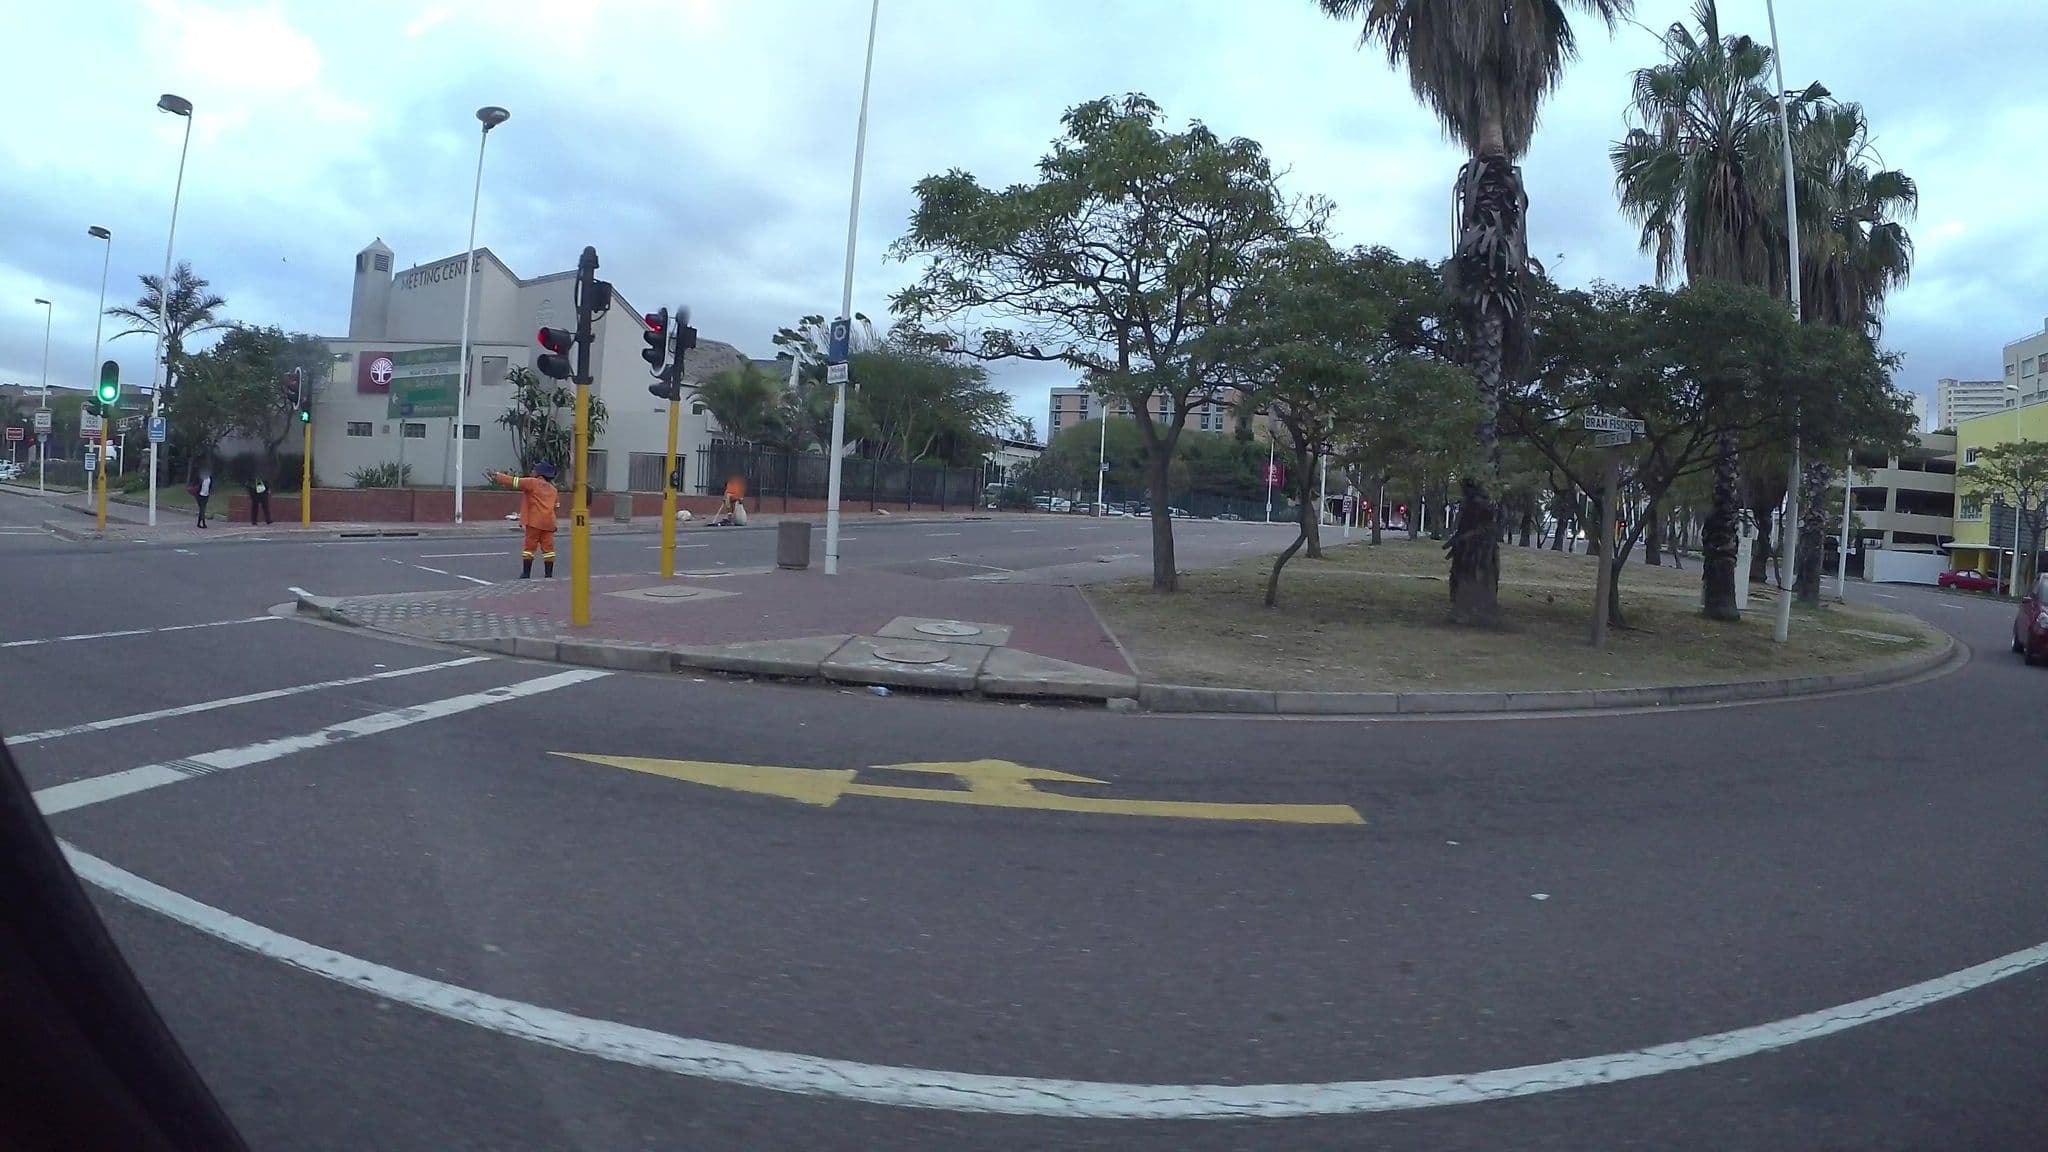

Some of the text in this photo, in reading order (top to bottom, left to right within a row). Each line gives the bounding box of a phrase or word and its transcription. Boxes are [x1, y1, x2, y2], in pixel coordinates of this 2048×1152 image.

[401, 267, 440, 289] MEETING
[154, 419, 161, 427] P
[1586, 417, 1607, 428] BRAM
[1610, 419, 1639, 431] FISCHER
[576, 515, 584, 526] R
